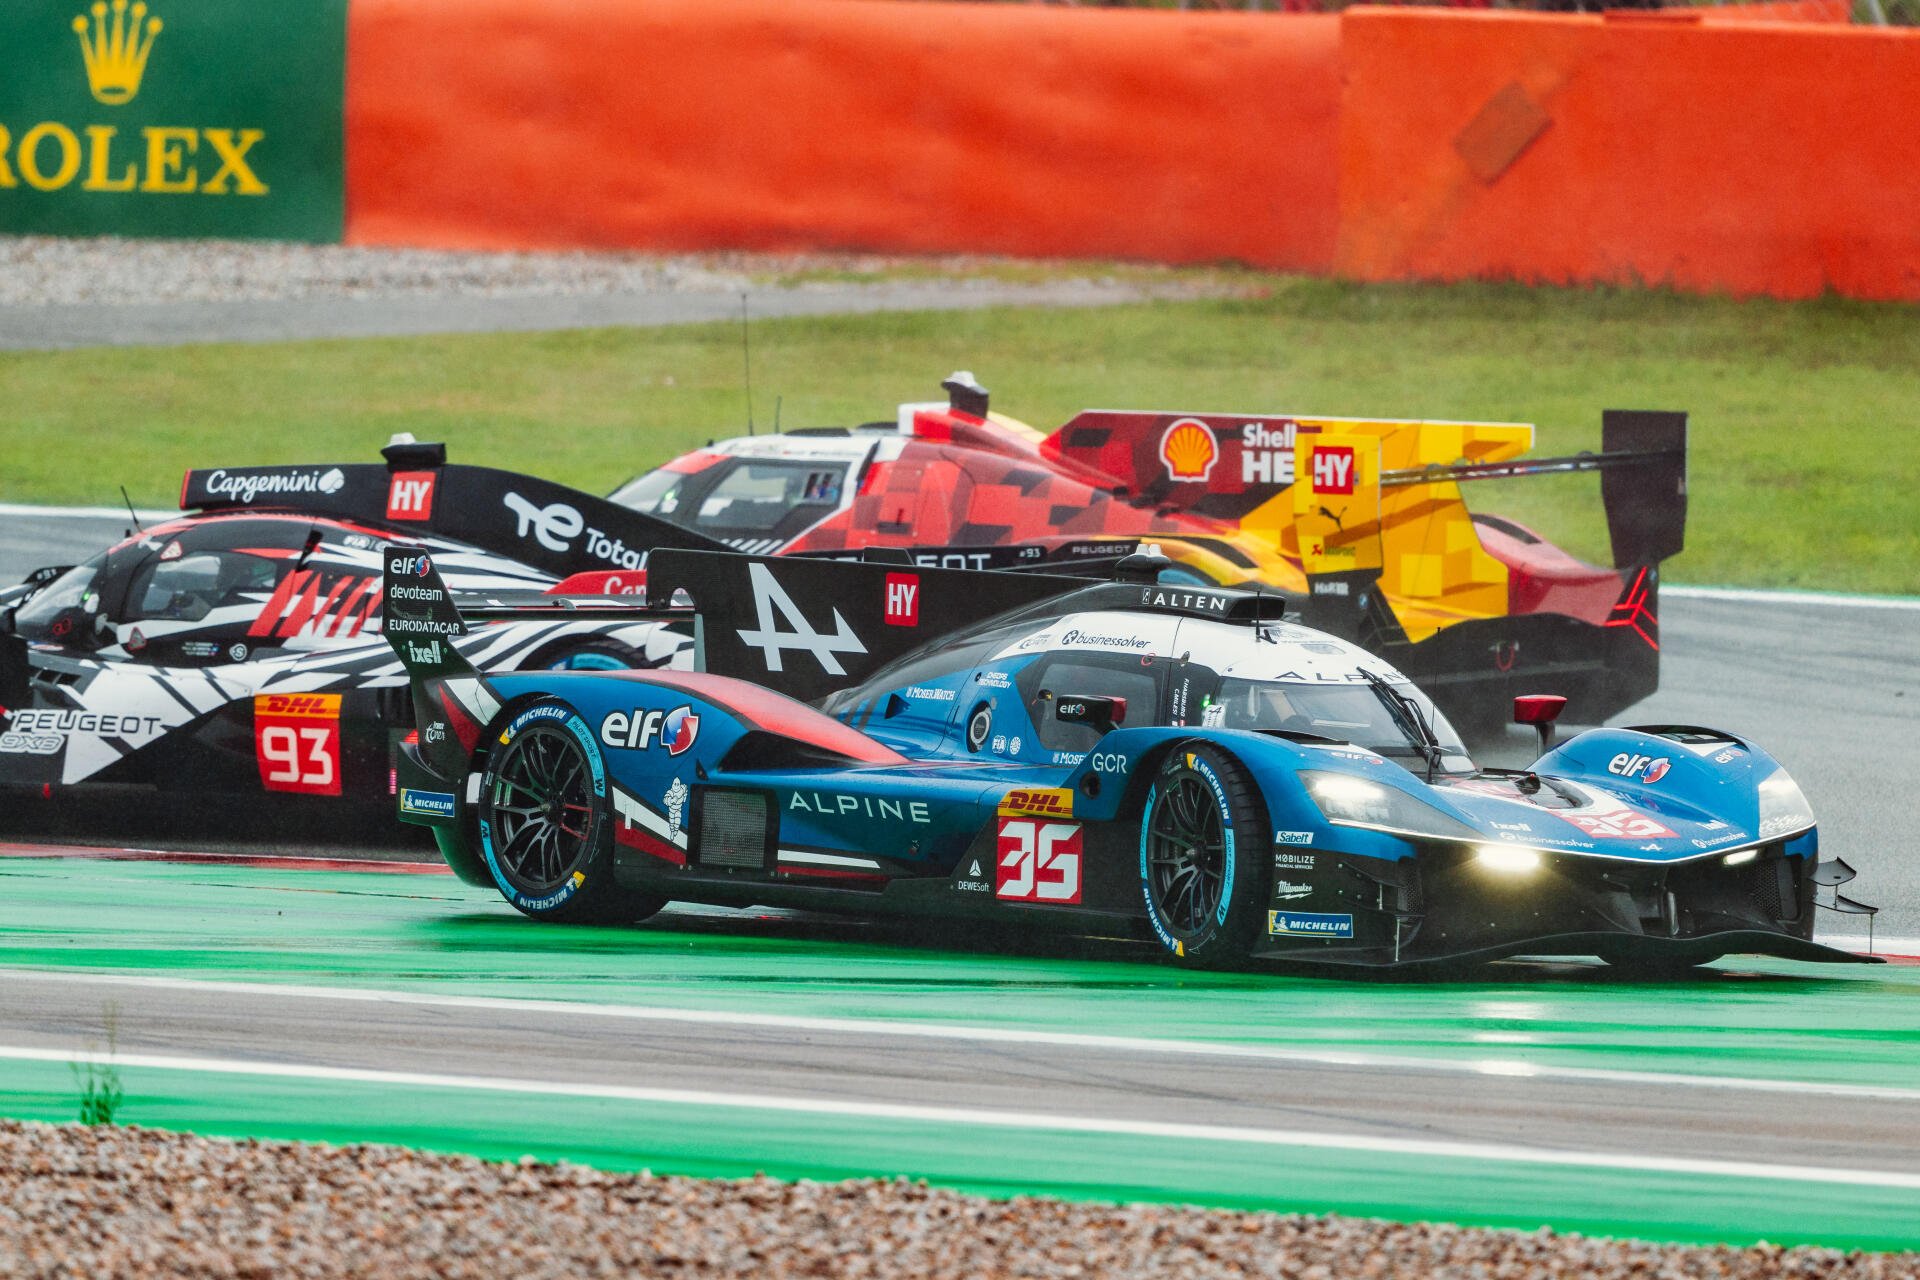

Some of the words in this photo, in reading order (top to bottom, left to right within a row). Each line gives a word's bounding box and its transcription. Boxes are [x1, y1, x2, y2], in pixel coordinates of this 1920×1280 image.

[1242, 422, 1297, 448] Shell
[1314, 453, 1352, 487] HY
[206, 469, 319, 503] Capgemini
[391, 480, 431, 511] HY
[1072, 544, 1131, 555] PEUGEOT
[390, 557, 416, 574] elf
[390, 584, 443, 601] devoteam
[887, 583, 917, 616] HY
[1153, 592, 1226, 611] ALTEN
[389, 619, 460, 634] EURODATACAR
[1076, 632, 1152, 648] businessolver
[408, 640, 442, 664] ixell
[266, 695, 328, 714] DHL
[1060, 704, 1076, 714] elf
[14, 711, 162, 736] PEUGEOT
[516, 707, 567, 728] MICHELIN
[572, 721, 586, 736] PILOT
[583, 736, 598, 759] SPORT
[601, 709, 664, 749] elf
[1, 734, 62, 750] 9X8
[262, 725, 334, 785] 93
[1092, 752, 1128, 774] GCR
[1608, 752, 1652, 778] elf
[1009, 791, 1063, 813] DHL
[1200, 763, 1230, 820] MICHELIN
[414, 798, 454, 811] MICHELIN
[789, 791, 931, 824] ALPINE
[1279, 832, 1309, 843] Sabelt
[1516, 834, 1596, 849] businessolver
[997, 821, 1081, 899] 35
[958, 880, 990, 892] DEWESoft
[1278, 880, 1313, 894] Milwaukee
[519, 888, 569, 910] MICHELIN
[1143, 888, 1171, 946] MICHELIN
[1289, 921, 1351, 931] MICHELIN
